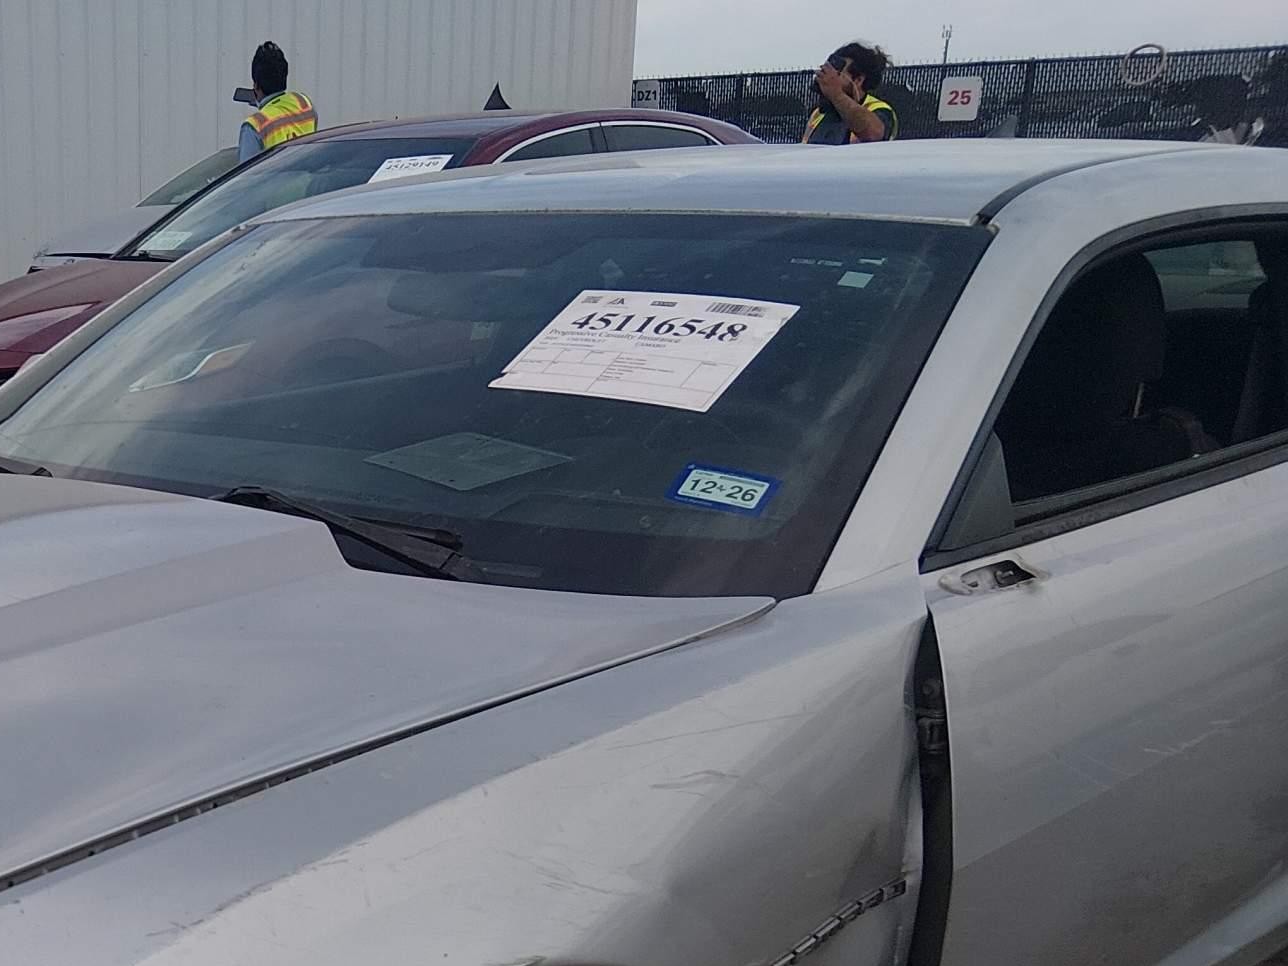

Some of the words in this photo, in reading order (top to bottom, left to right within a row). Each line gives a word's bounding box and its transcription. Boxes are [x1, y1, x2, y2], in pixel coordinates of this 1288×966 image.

[637, 90, 657, 101] DZ1
[947, 90, 972, 105] 25
[571, 312, 748, 341] 45116548
[690, 479, 717, 494] 12
[725, 485, 758, 502] 26
